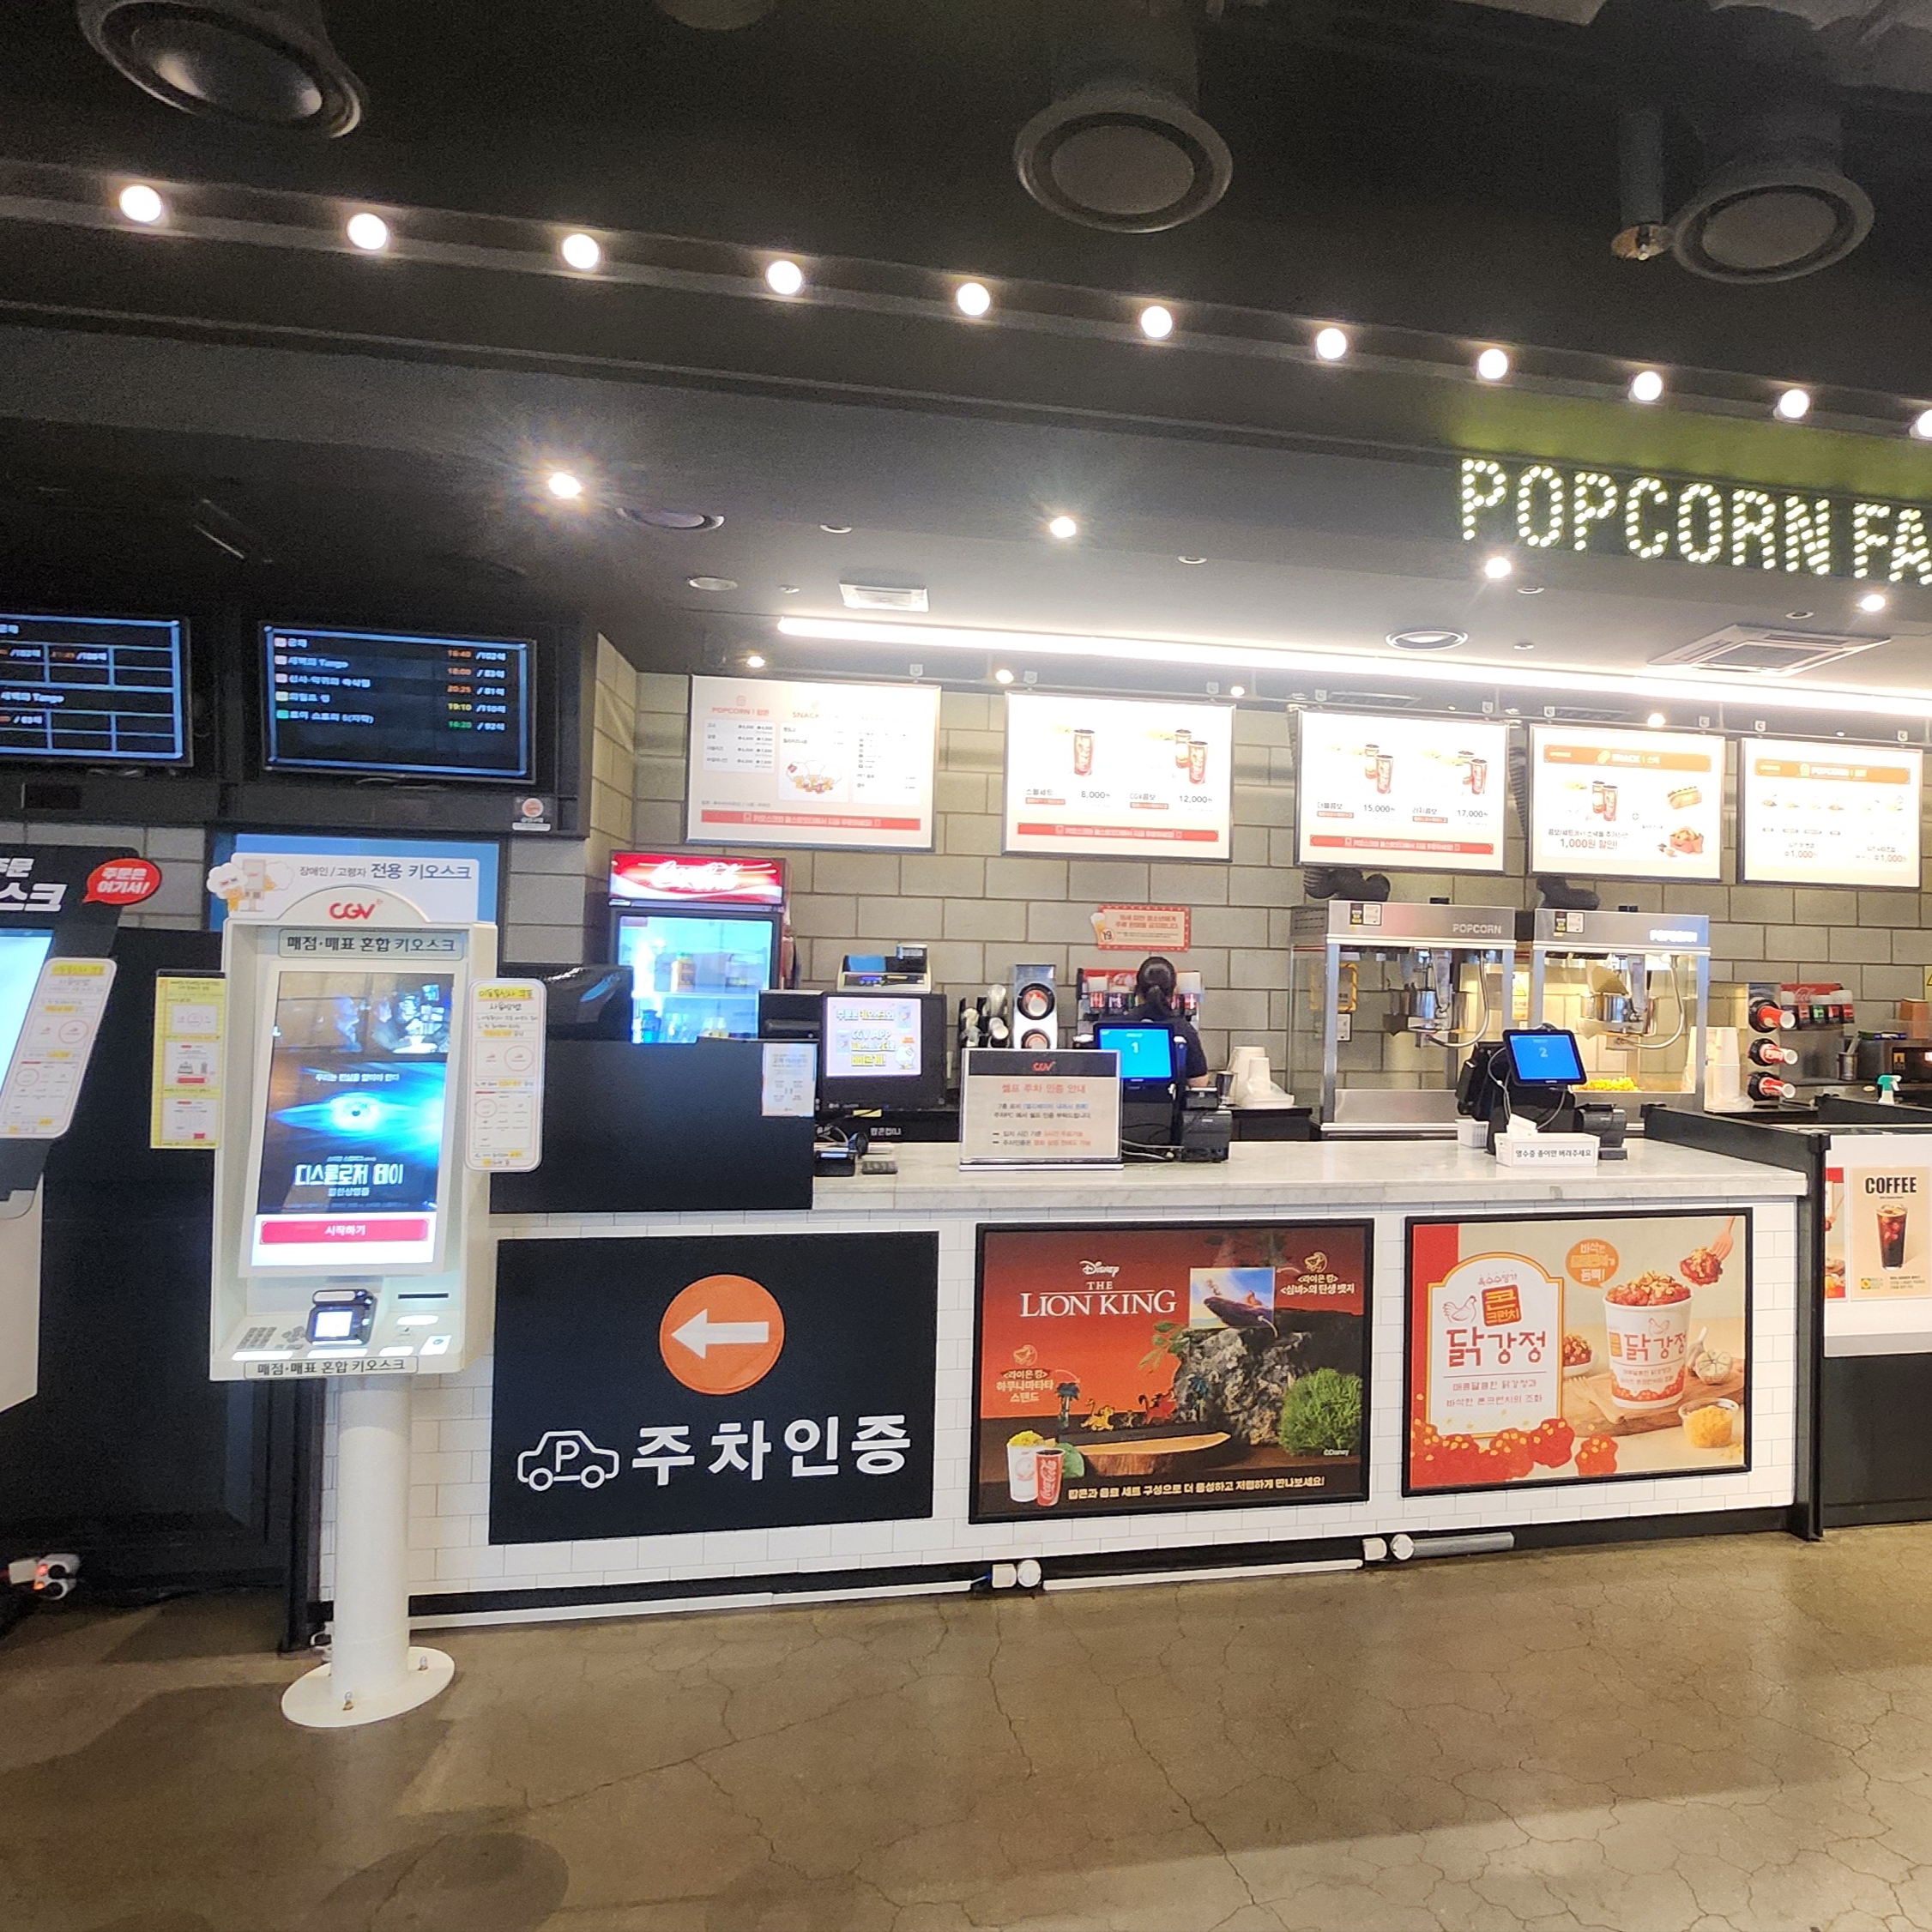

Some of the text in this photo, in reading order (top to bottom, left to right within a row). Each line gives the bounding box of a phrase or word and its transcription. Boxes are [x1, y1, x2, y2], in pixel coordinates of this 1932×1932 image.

[1461, 458, 1831, 576] POPCORN
[1560, 838, 1596, 849] 1,000원
[101, 866, 148, 881] 주문은
[299, 865, 329, 878] 장애인
[336, 866, 367, 878] 고령자
[370, 862, 403, 881] 전용
[408, 863, 473, 881] 키오스크
[96, 881, 151, 895] 여기서!
[329, 902, 376, 921] CGV
[1452, 923, 1501, 935] POPCORN
[359, 937, 391, 954] 혼합
[395, 937, 456, 953] 키오스크
[851, 1029, 891, 1040] CGV APP
[1539, 1047, 1549, 1058] 2
[1001, 1084, 1086, 1094] 셀프 주차 인증 안내
[1515, 1149, 1591, 1158] 영수증 종이만 버려주세요
[1865, 1176, 1917, 1194] COFFEE
[324, 1224, 366, 1236] 시작하기
[1079, 1259, 1120, 1277] Disney
[1086, 1281, 1114, 1291] THE
[1319, 1283, 1337, 1295] 탄생
[1019, 1289, 1177, 1318] LION KING
[1486, 1289, 1516, 1311] 콘
[1486, 1307, 1519, 1325] 크런치
[1446, 1326, 1546, 1368] 닭강정
[1624, 1332, 1687, 1361] 닭강정
[321, 1361, 348, 1374] 혼합
[352, 1360, 406, 1374] 키오스크
[1010, 1392, 1040, 1404] 스탠드
[1446, 1398, 1473, 1407] 바삭한
[1525, 1393, 1543, 1403] 조화
[631, 1415, 911, 1486] 주차인증
[1121, 1487, 1142, 1498] 세트
[1143, 1484, 1182, 1496] 구성으로
[1184, 1482, 1194, 1494] 더
